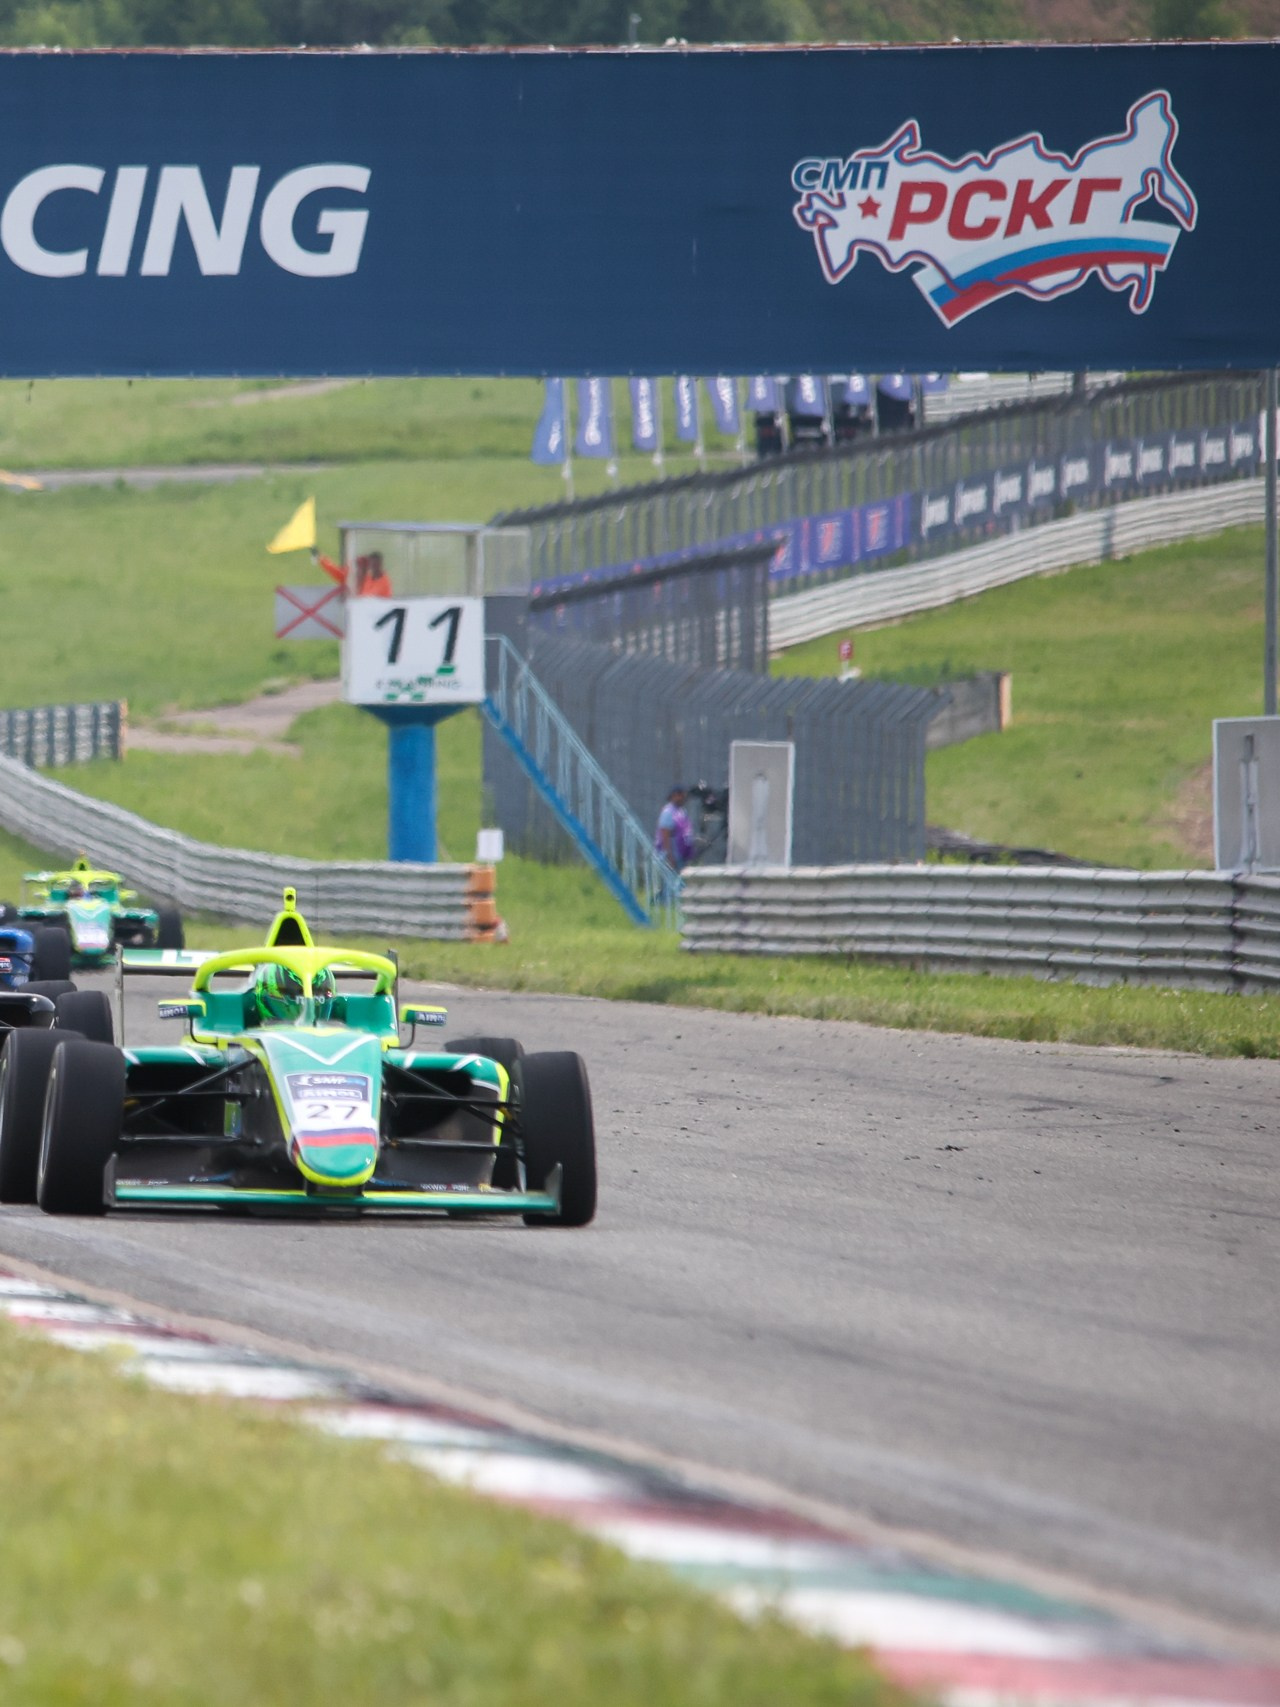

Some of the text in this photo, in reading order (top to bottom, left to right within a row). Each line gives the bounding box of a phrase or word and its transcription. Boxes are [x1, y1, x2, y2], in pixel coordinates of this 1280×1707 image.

[793, 160, 890, 190] СМП
[887, 177, 1123, 241] РСКГ
[374, 607, 462, 664] 11
[306, 1103, 358, 1120] 27
